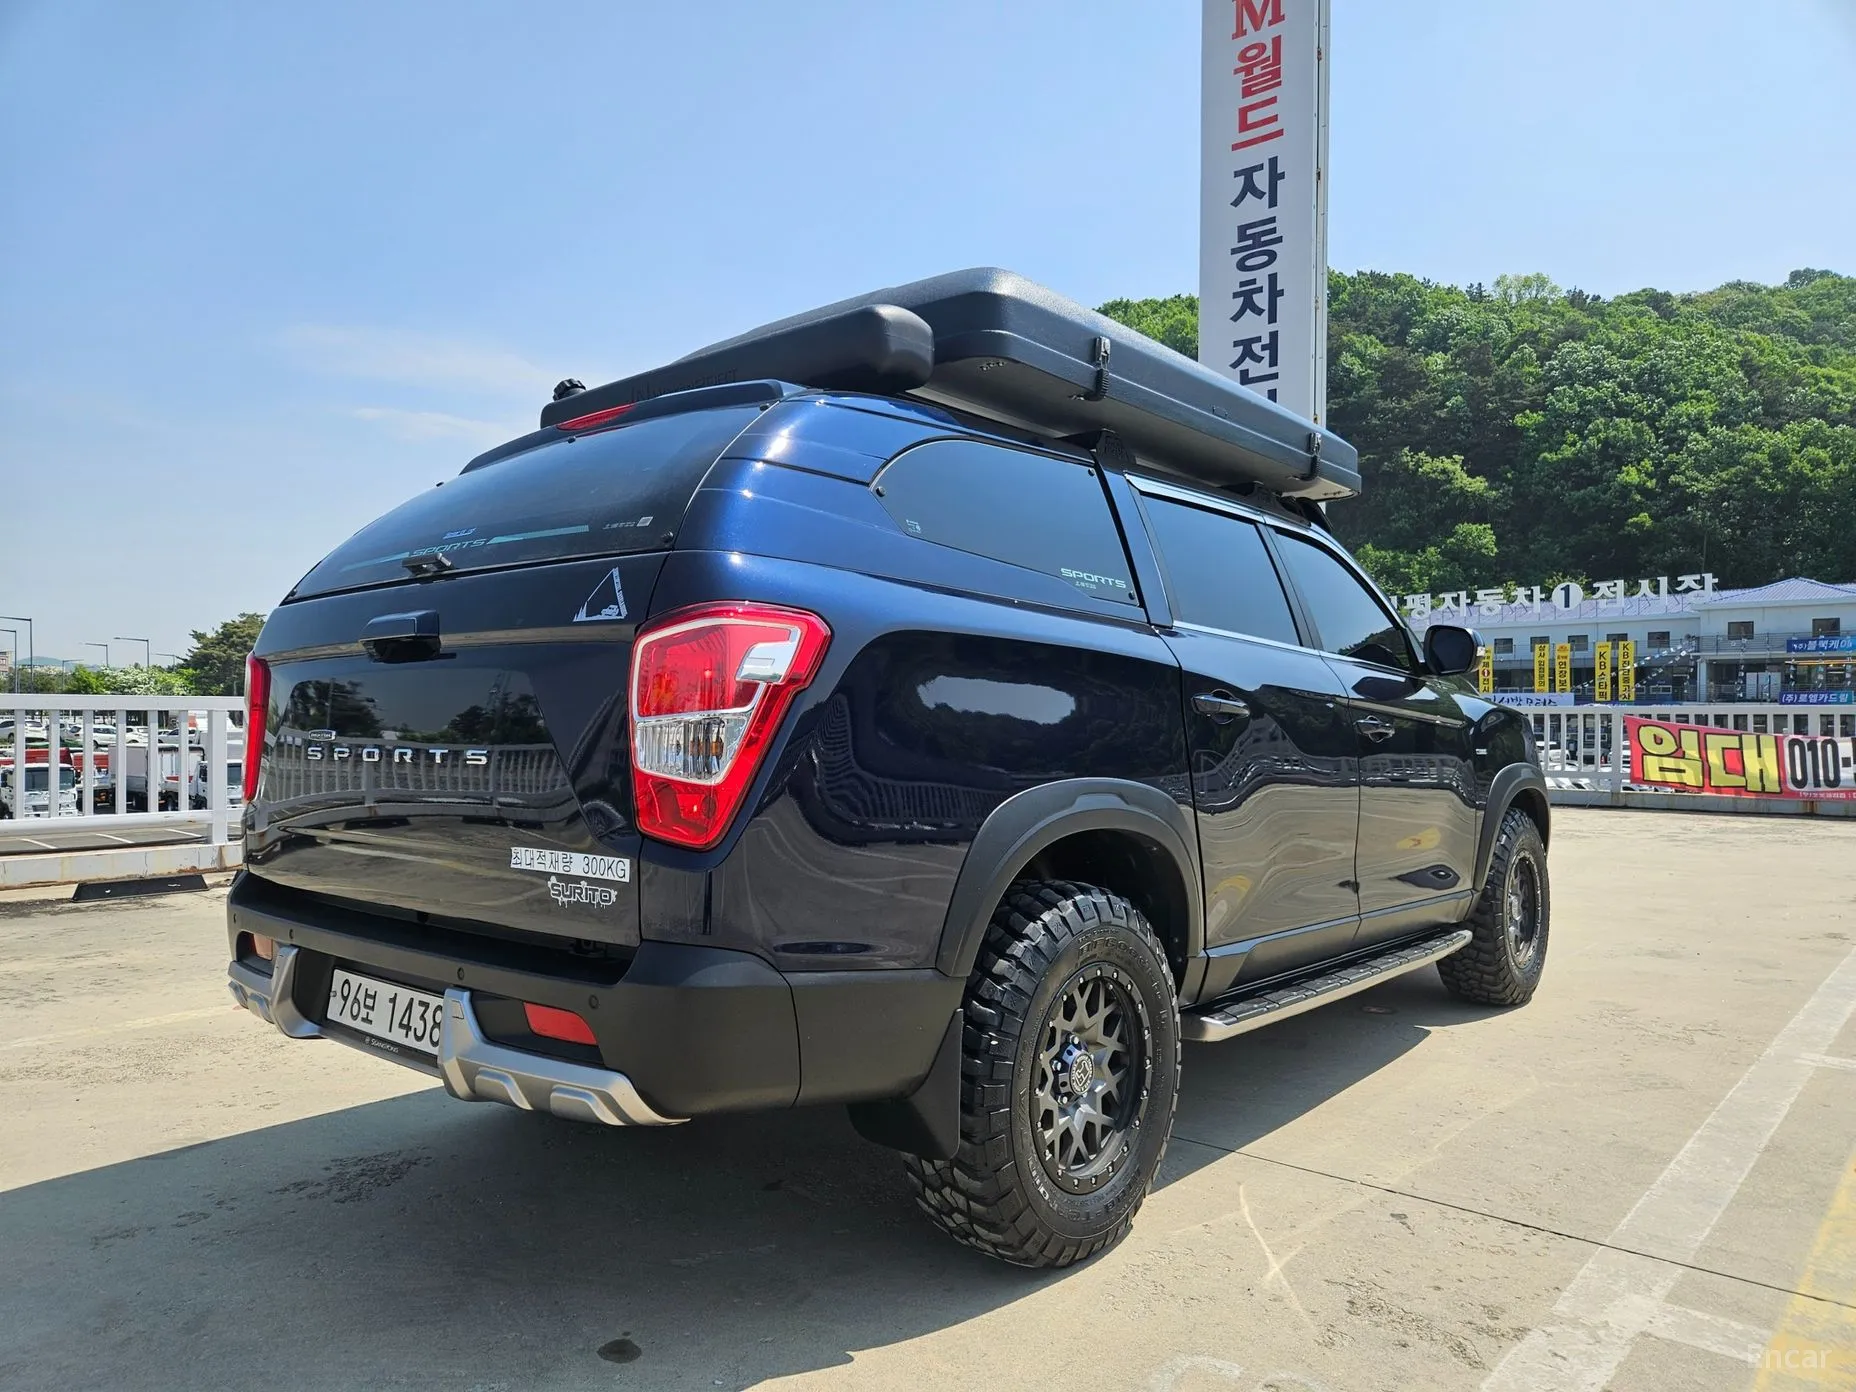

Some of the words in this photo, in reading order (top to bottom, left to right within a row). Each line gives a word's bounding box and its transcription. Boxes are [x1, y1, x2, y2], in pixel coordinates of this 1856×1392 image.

[1229, 155, 1285, 403] 자동차전
[412, 538, 487, 558] SPORTS
[1060, 567, 1127, 589] SPORTS
[307, 746, 489, 766] SPORTS
[1637, 724, 1782, 795] 임대
[1788, 737, 1856, 790] 010-
[511, 848, 574, 874] 최대적재량
[582, 855, 627, 880] 300KG
[549, 881, 614, 906] SURITO
[339, 978, 378, 1026] 96보
[388, 992, 443, 1047] 1438
